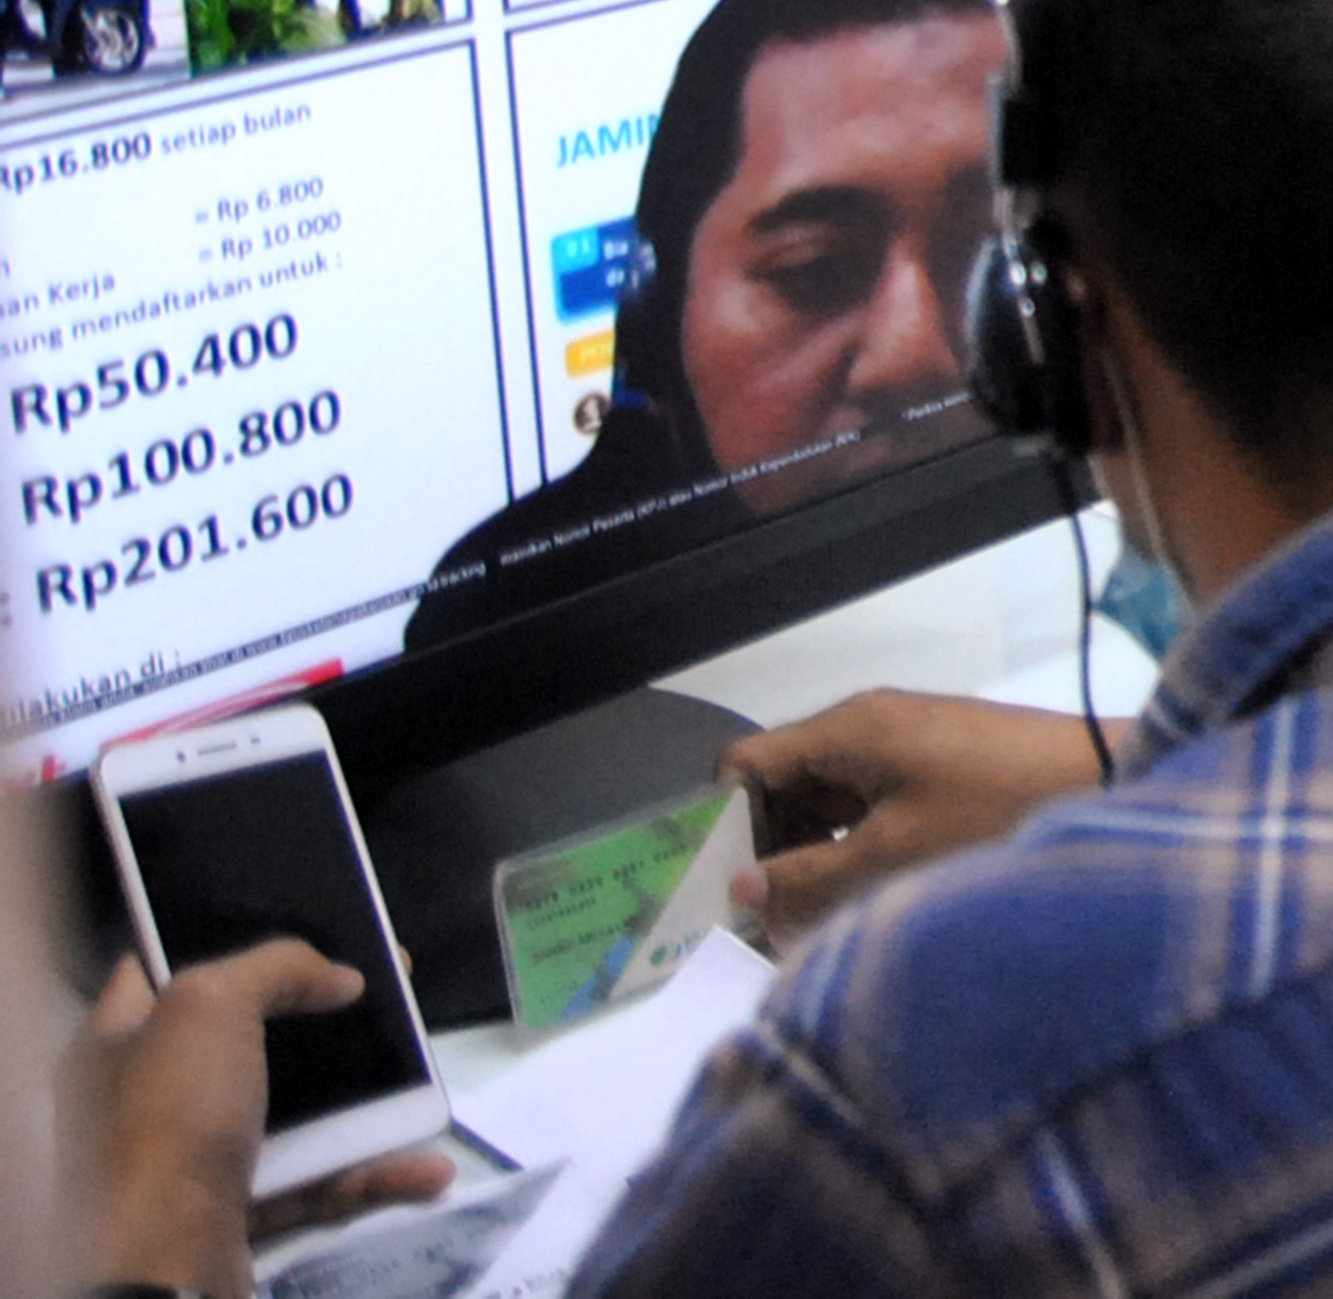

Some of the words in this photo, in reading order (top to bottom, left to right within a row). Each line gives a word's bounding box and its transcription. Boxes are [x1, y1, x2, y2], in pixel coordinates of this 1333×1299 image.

[160, 119, 237, 156] setiap
[244, 103, 312, 135] bulan
[217, 198, 249, 222] Rp
[256, 177, 324, 211] 6.800
[221, 236, 253, 261] Rp
[262, 211, 342, 249] 10.000
[48, 272, 116, 307] Kerja
[72, 278, 252, 339] mendaftarkan
[260, 253, 328, 289] untuk
[10, 313, 299, 436] Rp50.400
[21, 390, 341, 526] Rp100.800
[36, 473, 354, 614] Rp201.600
